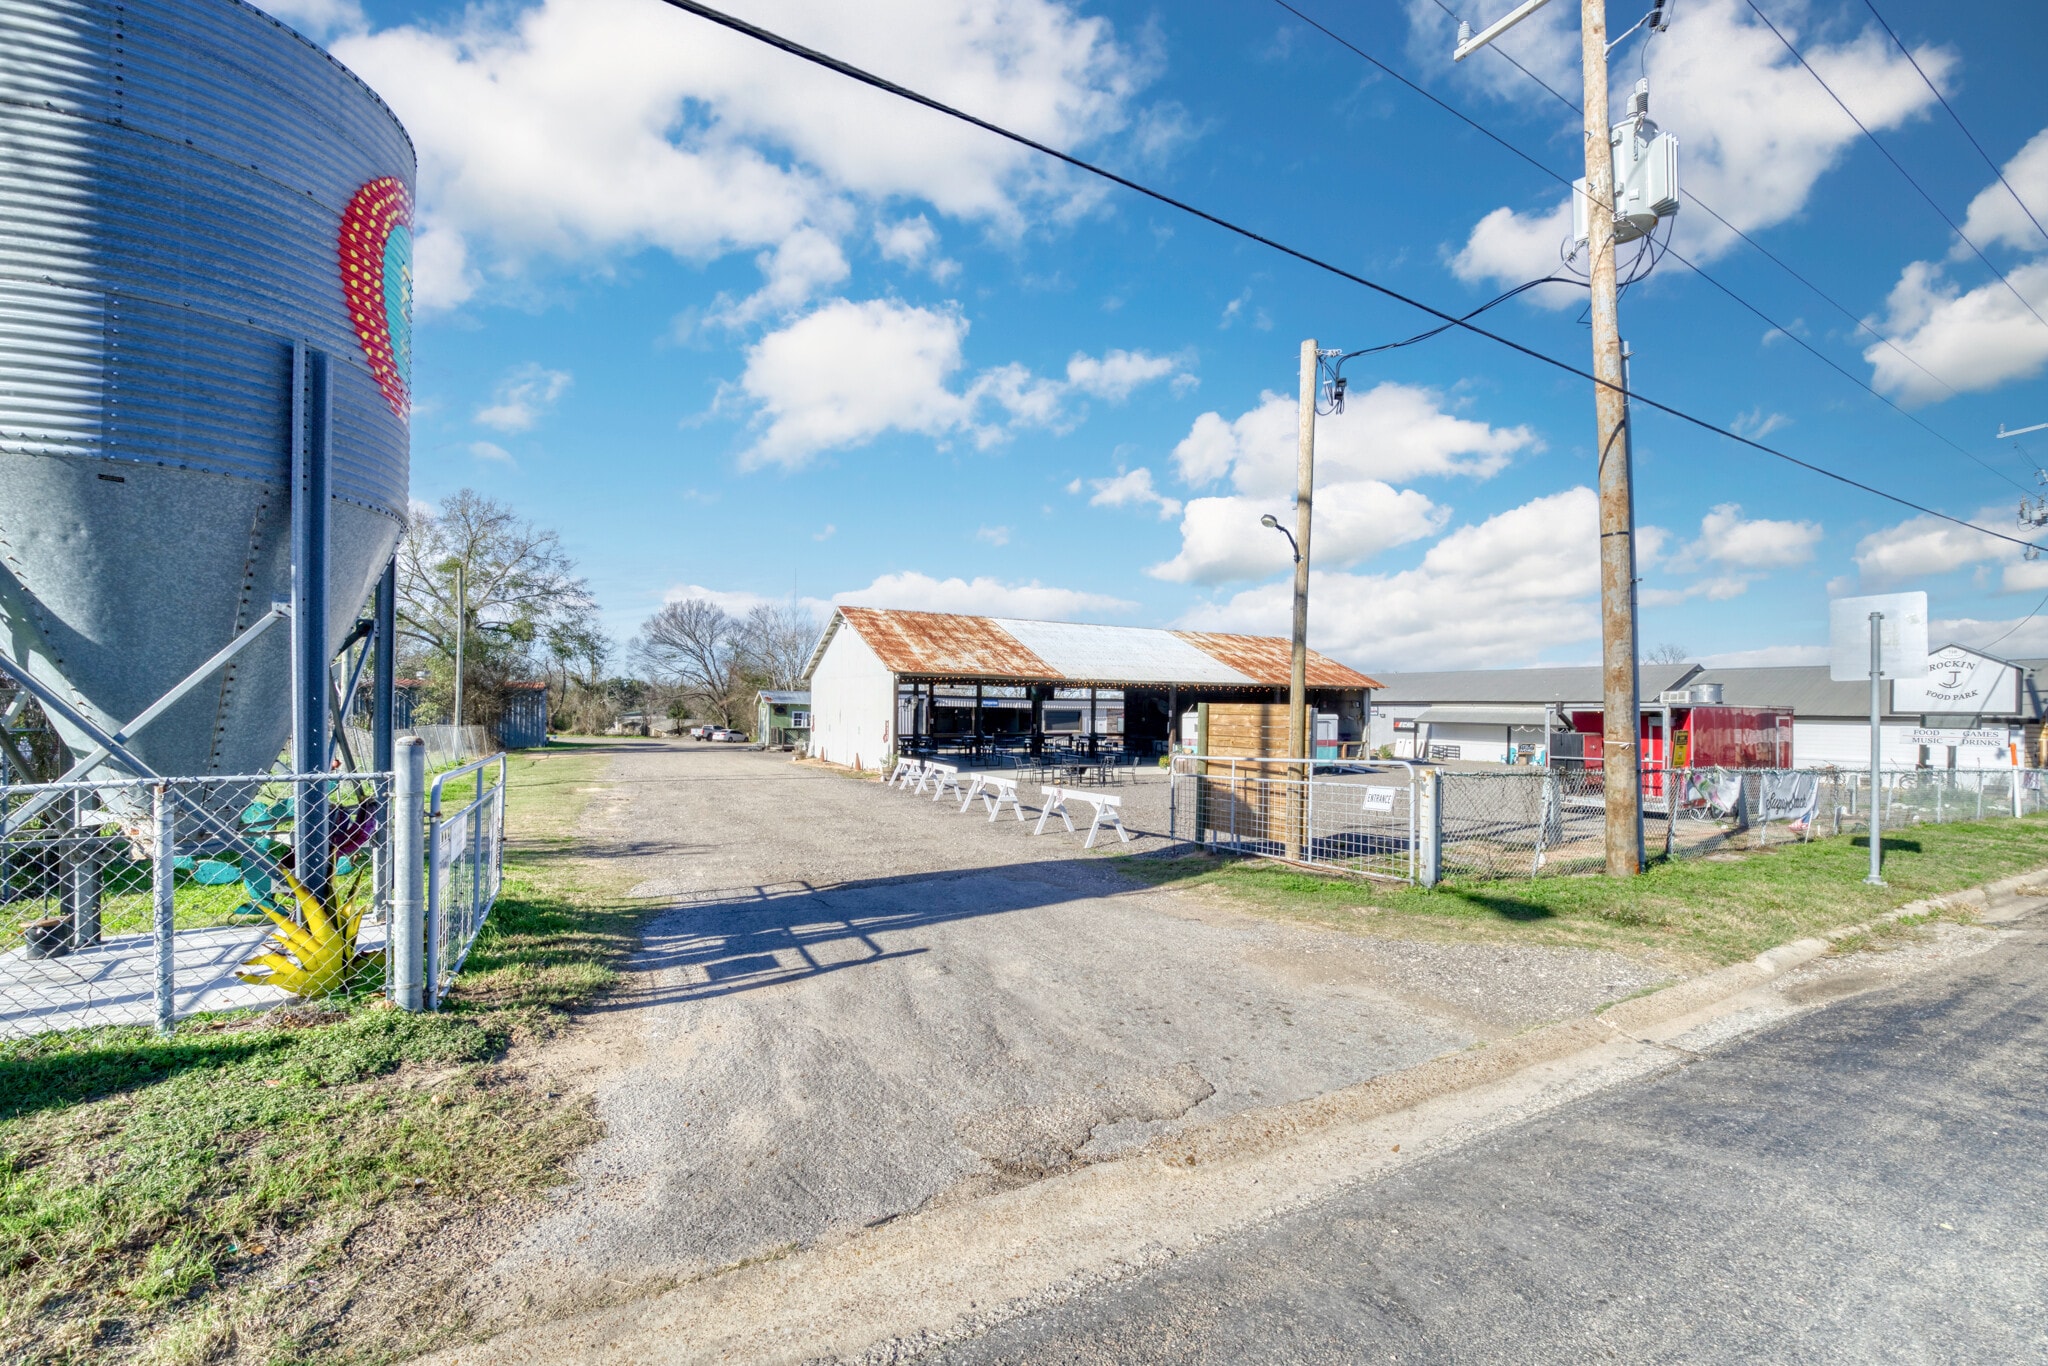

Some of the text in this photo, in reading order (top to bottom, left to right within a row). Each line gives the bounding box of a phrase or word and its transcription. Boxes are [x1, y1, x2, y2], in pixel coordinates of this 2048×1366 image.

[1929, 660, 1976, 672] ROCKIN
[1942, 671, 1961, 686] J
[1926, 689, 1979, 701] FOOD PARK
[1962, 730, 1999, 738] GAMES
[1961, 739, 2001, 747] DRINKS
[1367, 793, 1392, 804] ENTRANCE
